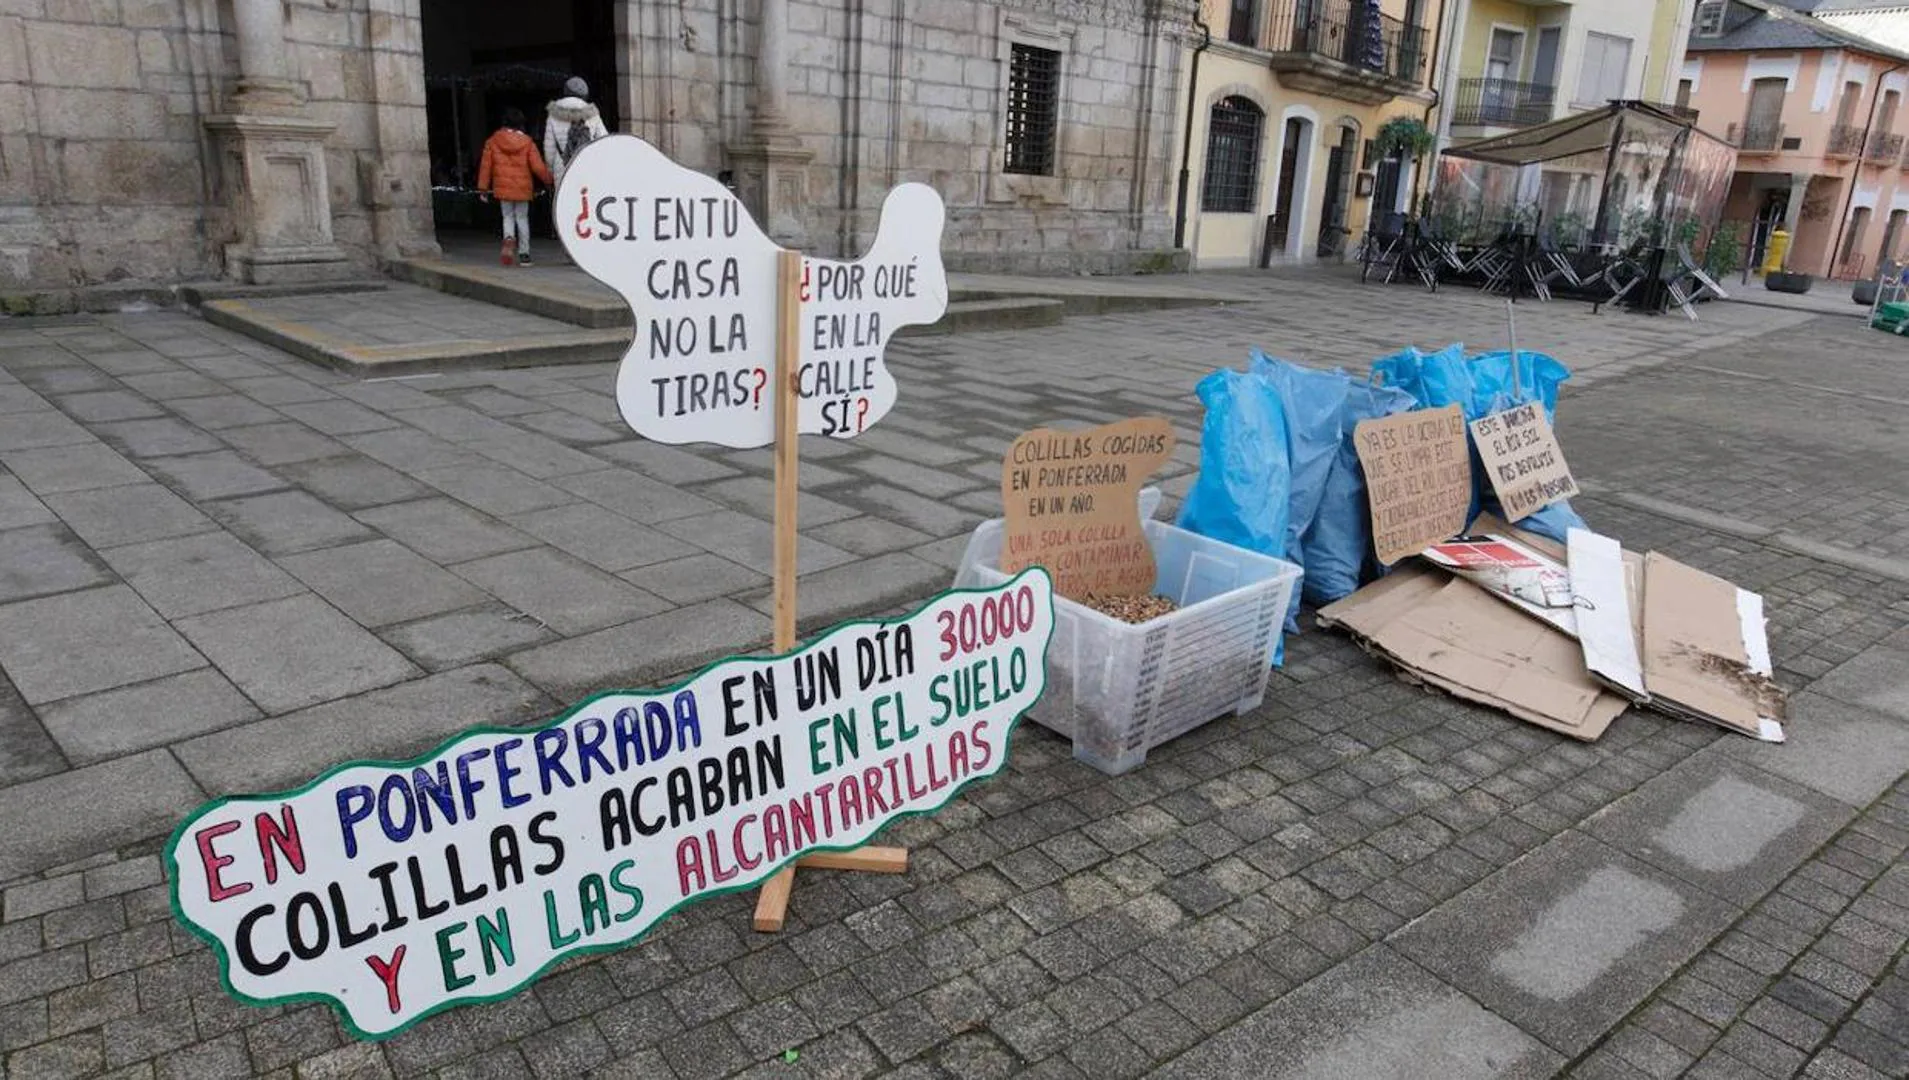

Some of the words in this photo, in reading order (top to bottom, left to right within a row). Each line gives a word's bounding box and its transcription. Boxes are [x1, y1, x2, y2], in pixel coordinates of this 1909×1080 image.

[574, 186, 639, 242] ¿SI
[653, 197, 694, 241] EN
[700, 197, 739, 239] TU
[647, 257, 740, 300] CASA
[801, 260, 865, 302] ¿POR
[874, 256, 918, 300] QUÉ
[650, 317, 696, 360] NO
[709, 313, 748, 353] LA
[814, 313, 845, 351] EN
[853, 312, 880, 347] LA
[651, 368, 767, 418] TIRAS?
[798, 357, 876, 399] CALLE
[821, 393, 869, 435] SÍ?
[1012, 436, 1093, 465] COLILLAS
[1102, 431, 1166, 456] COGIDAS
[1012, 469, 1030, 490] EN
[1038, 463, 1127, 489] PONFERRADA
[1029, 498, 1046, 517] EN
[1050, 497, 1065, 511] UN
[1009, 533, 1034, 555] UNA
[1041, 530, 1072, 549] SOLA
[1078, 523, 1127, 544] COLILLA
[1056, 541, 1144, 571] CONTAMINAR
[194, 801, 306, 903] EN
[336, 689, 702, 860] PONFERRADA
[721, 665, 779, 737] EN
[793, 646, 841, 712] UN
[856, 623, 915, 691] DÍA
[936, 585, 1035, 662] 30.000
[235, 811, 566, 977] COLILLAS
[599, 734, 785, 852] ACABAN
[807, 707, 860, 775] EN
[871, 693, 919, 751] EL
[928, 646, 1027, 728] SUELO
[365, 944, 406, 1014] Y
[436, 906, 515, 992] EN
[543, 859, 645, 950] LAS
[675, 720, 992, 897] ALCANTARILLAS
